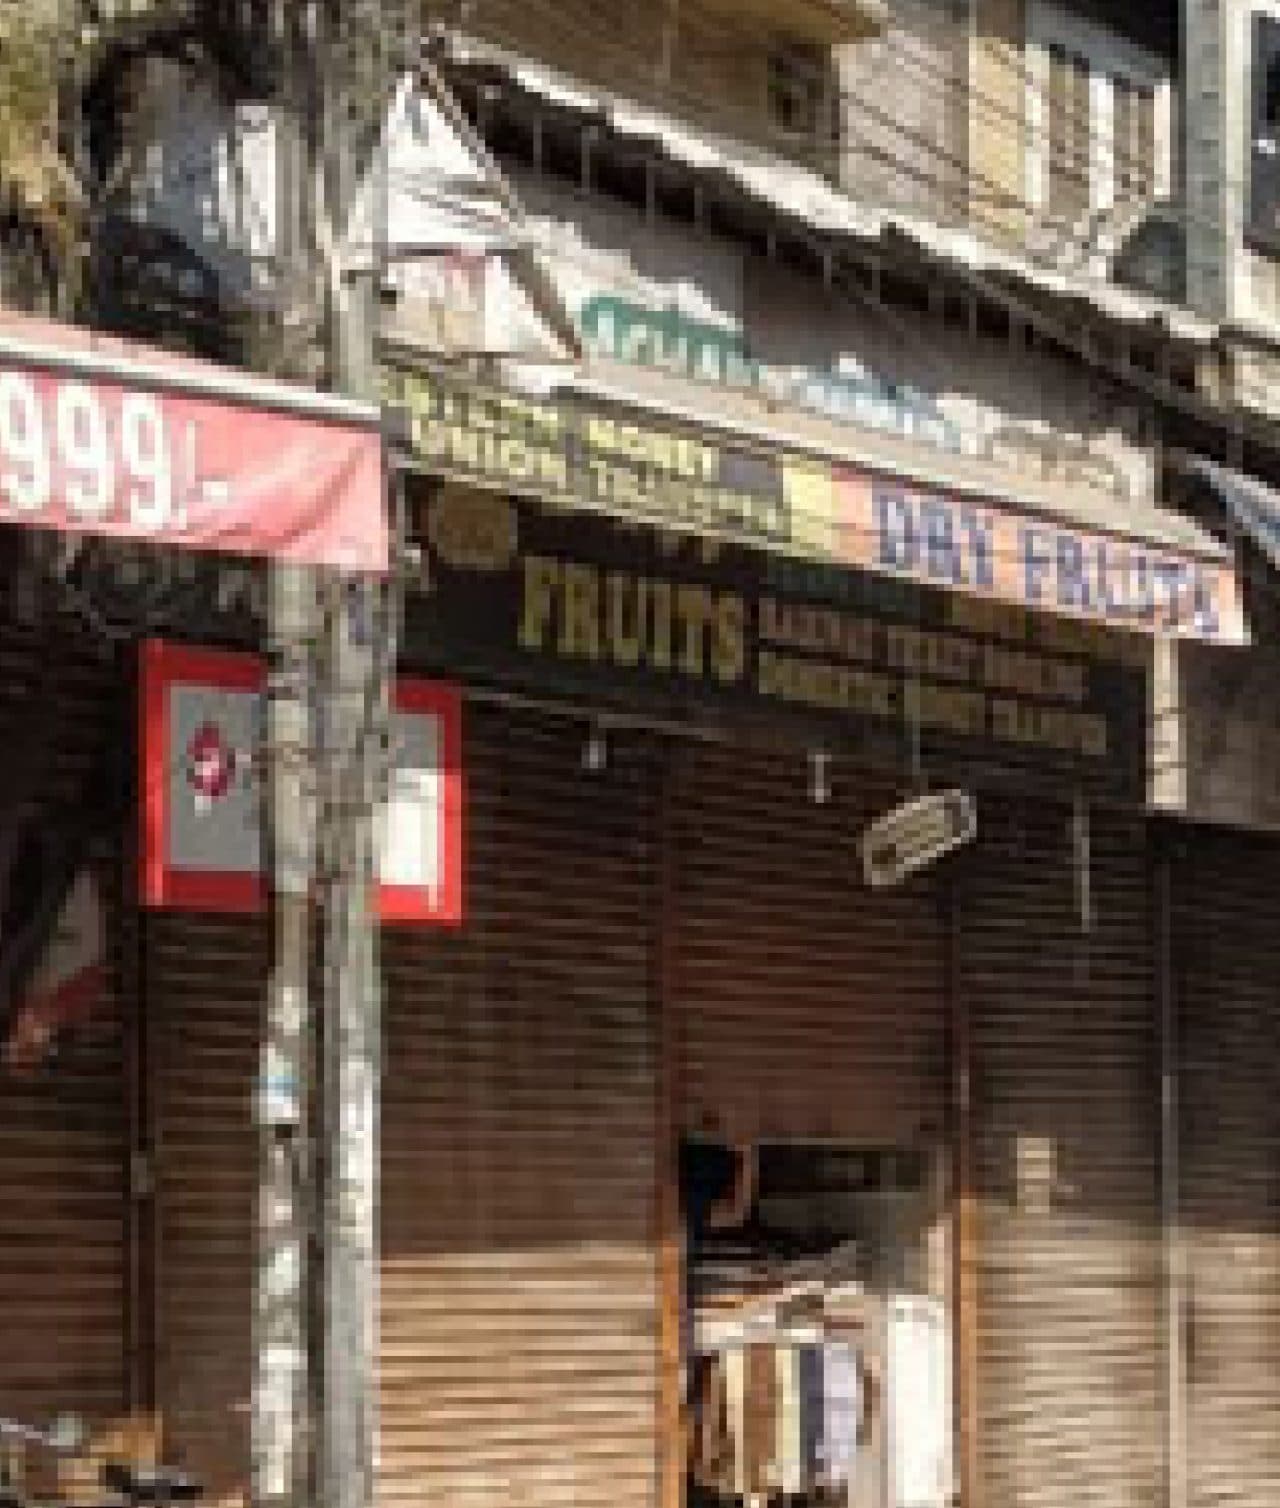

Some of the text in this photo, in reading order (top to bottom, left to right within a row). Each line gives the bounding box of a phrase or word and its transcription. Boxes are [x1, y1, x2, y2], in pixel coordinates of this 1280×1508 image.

[518, 556, 746, 684] FRUITS
[878, 492, 998, 586] DRY
[1022, 524, 1222, 634] FRUITS
